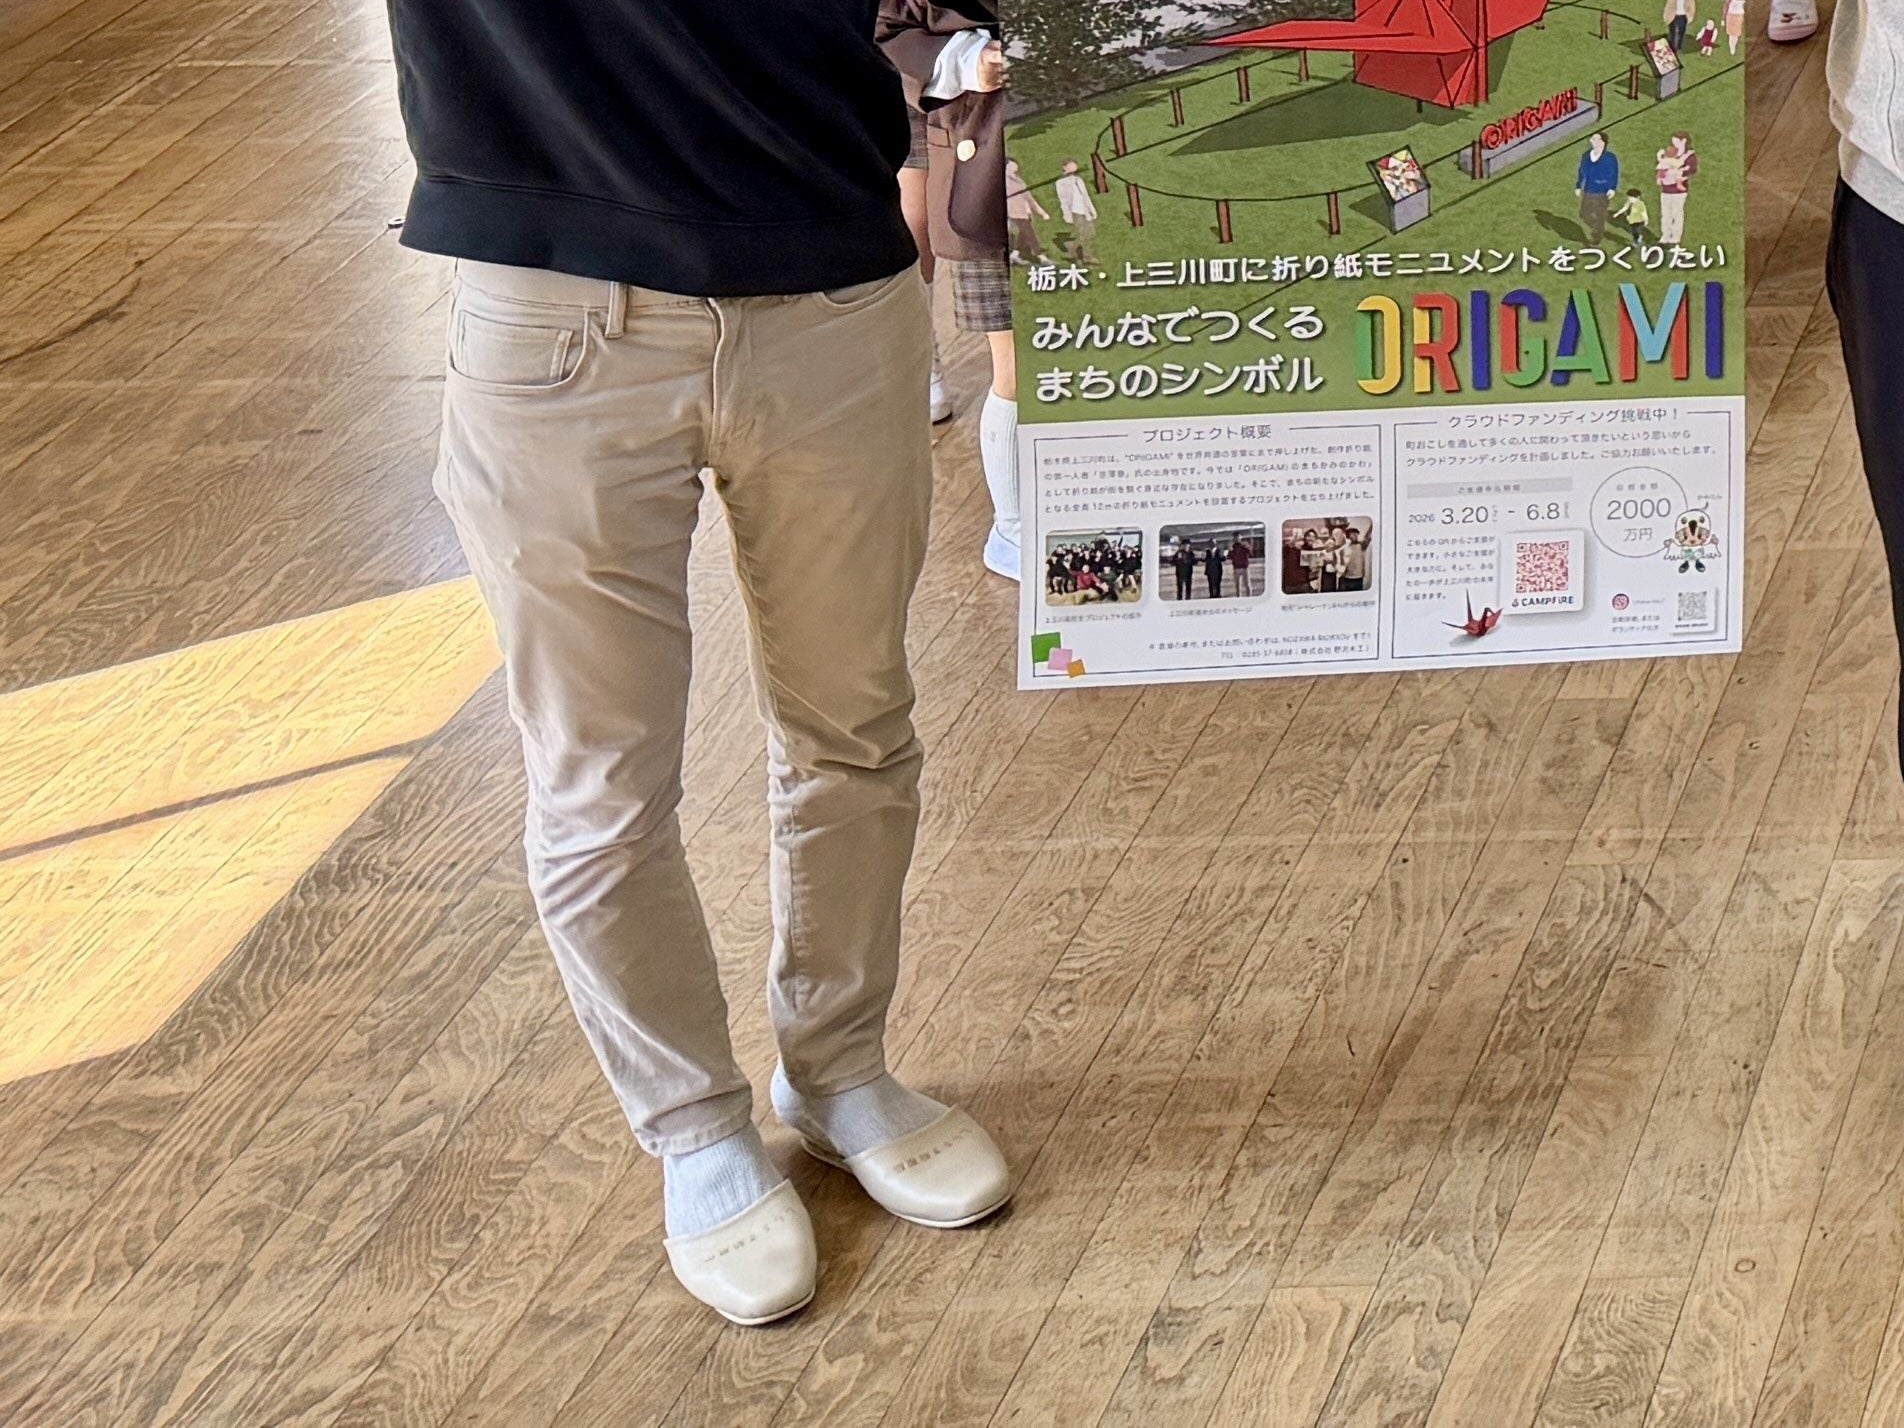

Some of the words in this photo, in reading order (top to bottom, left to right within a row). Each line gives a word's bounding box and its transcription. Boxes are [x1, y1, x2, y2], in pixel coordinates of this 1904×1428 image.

[1031, 305, 1325, 351] みんなでつくる
[1355, 281, 1725, 395] ORIGAMI
[1035, 353, 1325, 404] まちのシンボル
[1143, 424, 1273, 443] プロジェクト概要
[1441, 505, 1489, 525] 3.20
[1526, 502, 1561, 521] 6.8
[1606, 497, 1672, 521] 2000
[1624, 527, 1653, 542] 万円
[1521, 595, 1574, 607] CAMPFIRE
